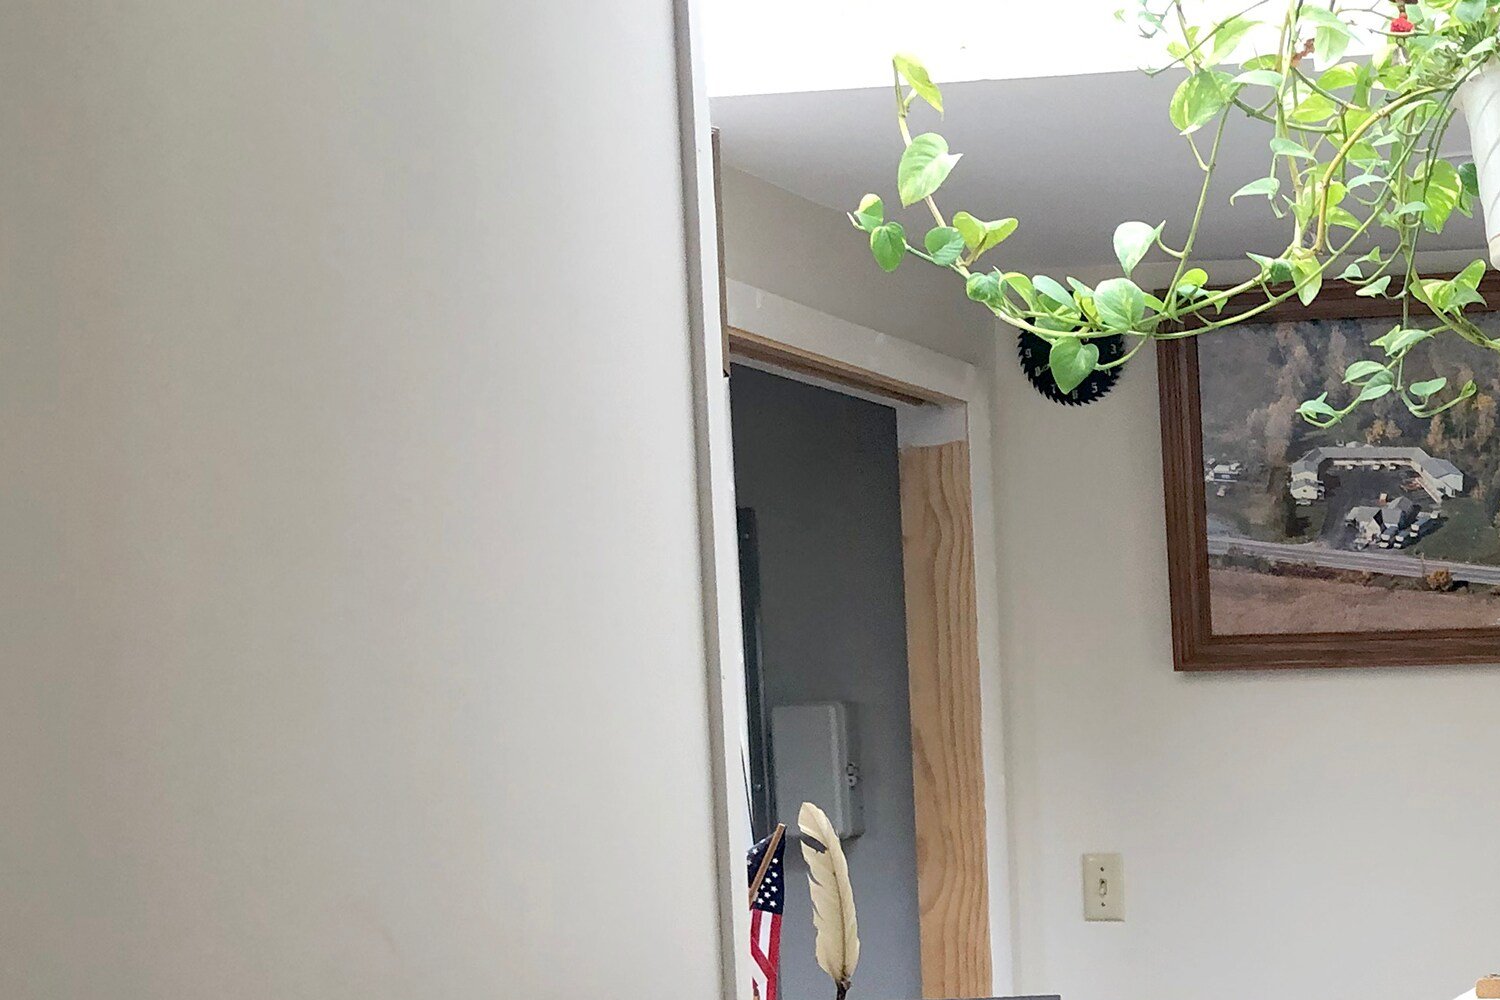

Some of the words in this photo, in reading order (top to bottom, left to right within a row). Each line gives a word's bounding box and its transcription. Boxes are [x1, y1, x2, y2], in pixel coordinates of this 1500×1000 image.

[1025, 348, 1032, 358] 9
[1110, 344, 1117, 354] 3
[1091, 382, 1098, 393] 5
